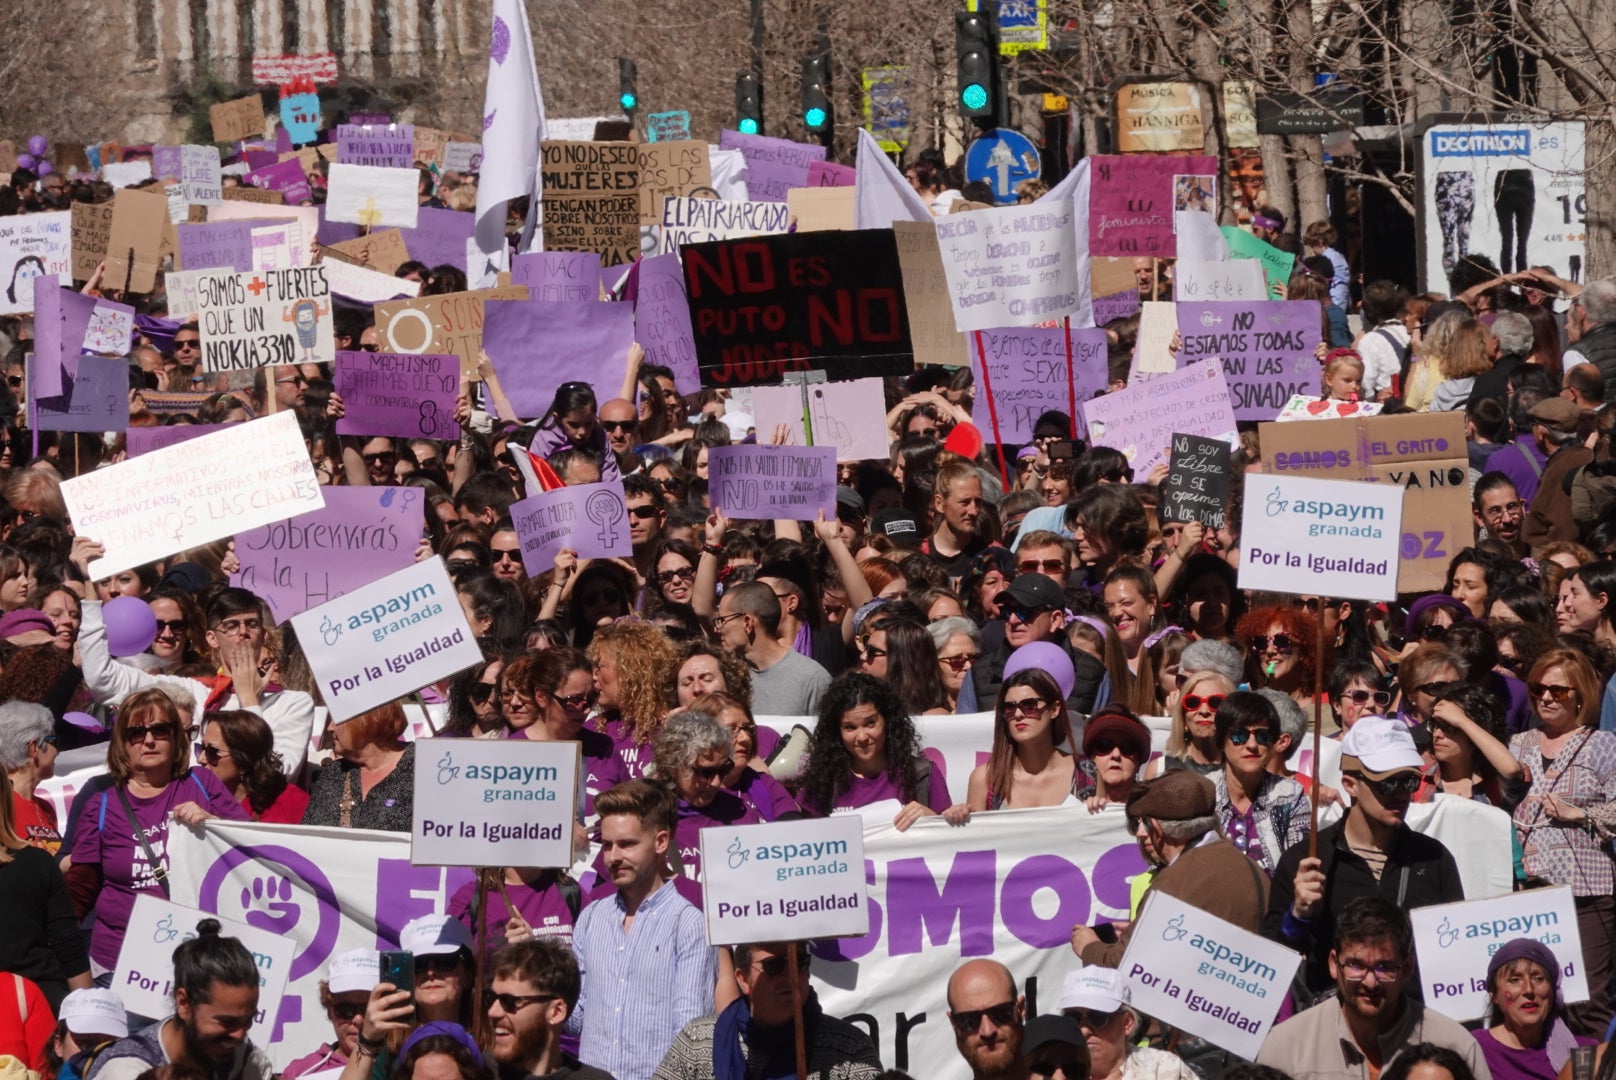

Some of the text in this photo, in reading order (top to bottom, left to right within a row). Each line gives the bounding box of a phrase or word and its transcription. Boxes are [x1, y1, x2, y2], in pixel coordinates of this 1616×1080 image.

[541, 145, 638, 165] YO NO DESEO
[1436, 134, 1526, 153] DECATHLON
[575, 163, 593, 171] QUE
[669, 148, 703, 167] LAS
[541, 171, 639, 190] MUJERES
[677, 166, 703, 186] DE
[543, 199, 597, 213] TENGAN
[600, 197, 636, 212] PODER
[664, 196, 686, 227] EL
[688, 198, 789, 231] PATRIARCADO
[544, 212, 640, 226] SOBRE NOSOTROS
[936, 217, 978, 240] DECIR
[1097, 214, 1172, 240] feminista
[557, 225, 623, 237] SINO SOBRE
[578, 236, 615, 247] ELLAS
[684, 241, 832, 299] NO ES
[199, 274, 245, 308] SOMOS
[265, 266, 329, 302] FUERTES
[206, 306, 265, 336] QUE UN
[697, 287, 901, 347] PUTO NO
[1232, 310, 1255, 331] NO
[1183, 330, 1305, 356] ESTAMOS TODAS
[340, 352, 441, 374] EL MACHISMO
[710, 341, 813, 384] JODER
[1255, 356, 1284, 376] LAS
[342, 370, 379, 390] MATA
[413, 374, 435, 393] QUE
[437, 374, 455, 394] YO
[1149, 373, 1205, 396] AGRESIONES
[418, 399, 454, 439] 8M
[1174, 437, 1219, 457] NO SOY
[1274, 437, 1449, 471] SOMOS EL GRITO
[1176, 454, 1224, 474] Libre
[1170, 473, 1207, 491] SI SE
[1430, 467, 1465, 487] NO
[208, 491, 245, 520] LAS
[722, 479, 759, 510] NO
[1292, 499, 1385, 522] aspaym
[1308, 522, 1383, 539] granada
[1400, 531, 1447, 560] OZ
[240, 557, 293, 589] a la
[1249, 547, 1388, 577] Por la Igualdad
[347, 581, 436, 630] aspaym
[371, 600, 443, 643] granada
[329, 627, 465, 697] Por la Igualdad
[464, 763, 557, 784] aspaym
[483, 787, 557, 803] granada
[422, 820, 563, 843] Por la Igualdad
[755, 838, 848, 862] aspaym
[776, 859, 849, 882] granada
[718, 892, 859, 919] Por la Igualdad
[531, 924, 574, 936] eminism
[543, 915, 560, 925] con
[1465, 910, 1558, 939] aspaym
[1487, 931, 1562, 957] grda
[1189, 932, 1277, 983] aspaym
[127, 970, 160, 993] Por
[1197, 960, 1267, 1000] granada
[1432, 977, 1487, 999] Por la
[1128, 962, 1262, 1036] Por la Igualdad
